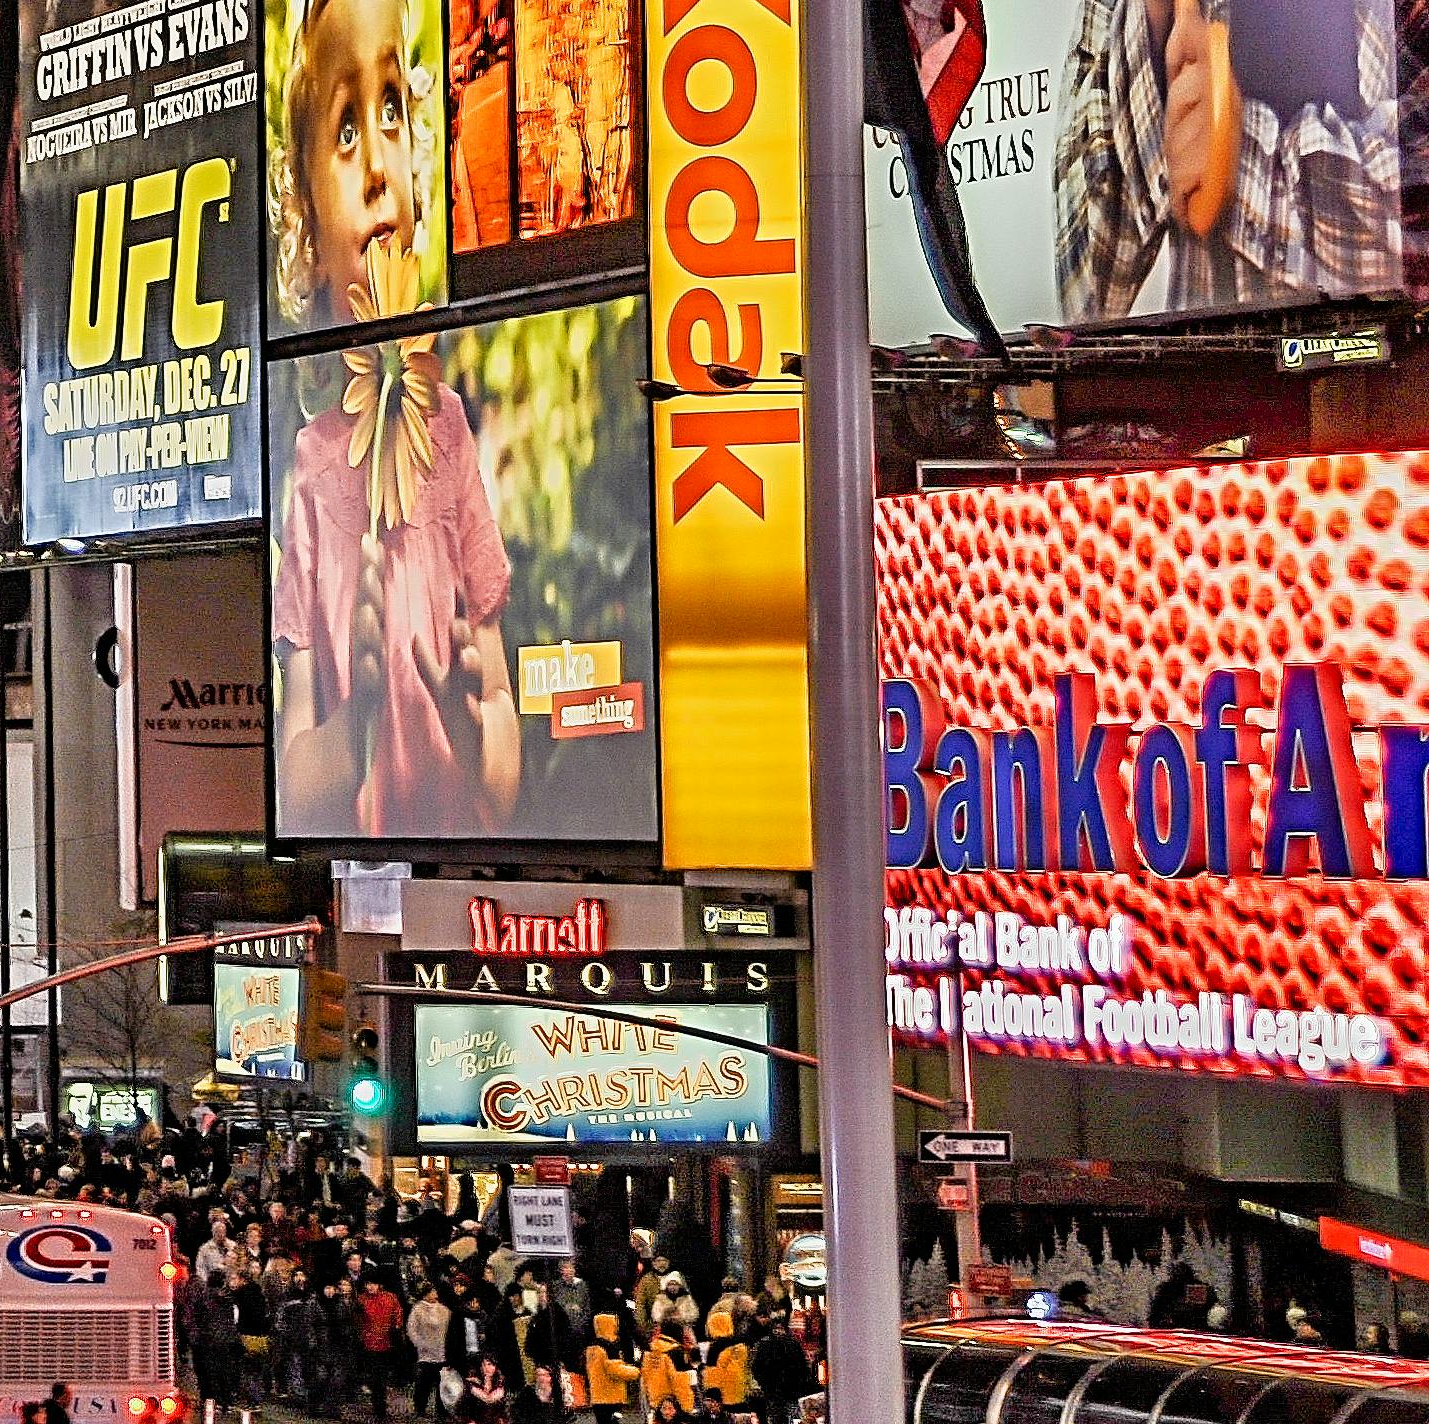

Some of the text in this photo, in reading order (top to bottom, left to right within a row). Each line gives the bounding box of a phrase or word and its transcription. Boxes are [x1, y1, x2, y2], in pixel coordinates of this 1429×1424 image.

[36, 30, 133, 102] GRIFFIN
[133, 19, 165, 72] VS
[26, 121, 93, 165] NOGUEIRA
[108, 108, 138, 142] MIR
[144, 89, 204, 139] JACKSON
[947, 128, 1040, 189] STMAS
[67, 157, 232, 370] UFC
[44, 347, 252, 438] SATURDAY, DEC. 27
[96, 429, 120, 476] ON
[120, 414, 232, 473] PAY-PER-VIEW
[521, 639, 597, 692] make
[882, 672, 1249, 869] Bank of
[469, 896, 605, 953] Marriott
[995, 910, 1082, 970] Bank
[1087, 907, 1127, 971] of
[411, 961, 758, 994] MARQUIS
[529, 1016, 672, 1056] WHITE
[1082, 982, 1223, 1049] Football
[1231, 990, 1388, 1068] League
[486, 1056, 739, 1127] CHRISTMAS
